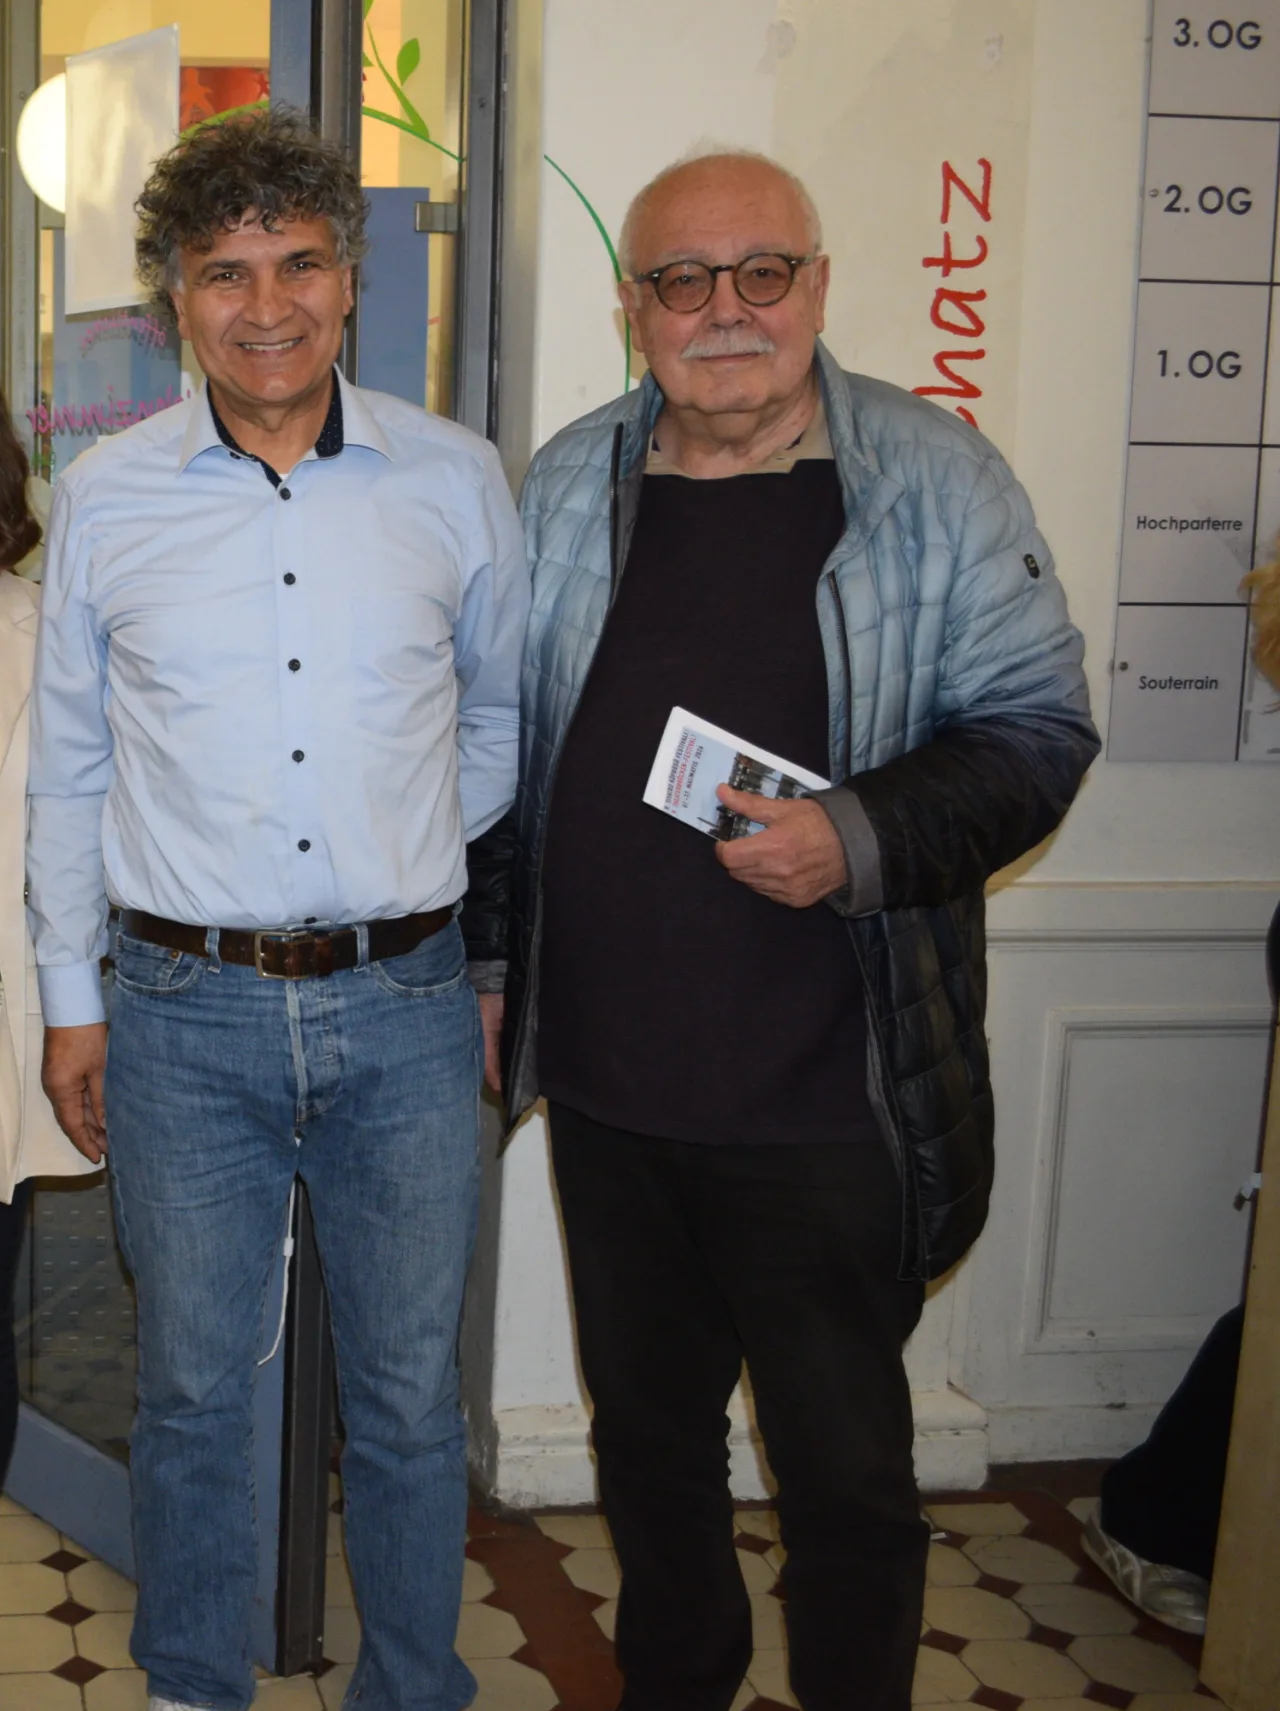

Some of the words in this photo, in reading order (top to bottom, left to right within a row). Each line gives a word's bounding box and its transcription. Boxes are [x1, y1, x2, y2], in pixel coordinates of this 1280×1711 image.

[1173, 18, 1199, 48] 3.
[1207, 19, 1263, 50] OG
[1163, 184, 1191, 214] 2.
[1197, 185, 1253, 216] OG
[1157, 350, 1181, 378] 1.
[1187, 350, 1243, 380] OG
[1136, 515, 1243, 533] Hochparterre
[1138, 675, 1219, 690] Souterrain
